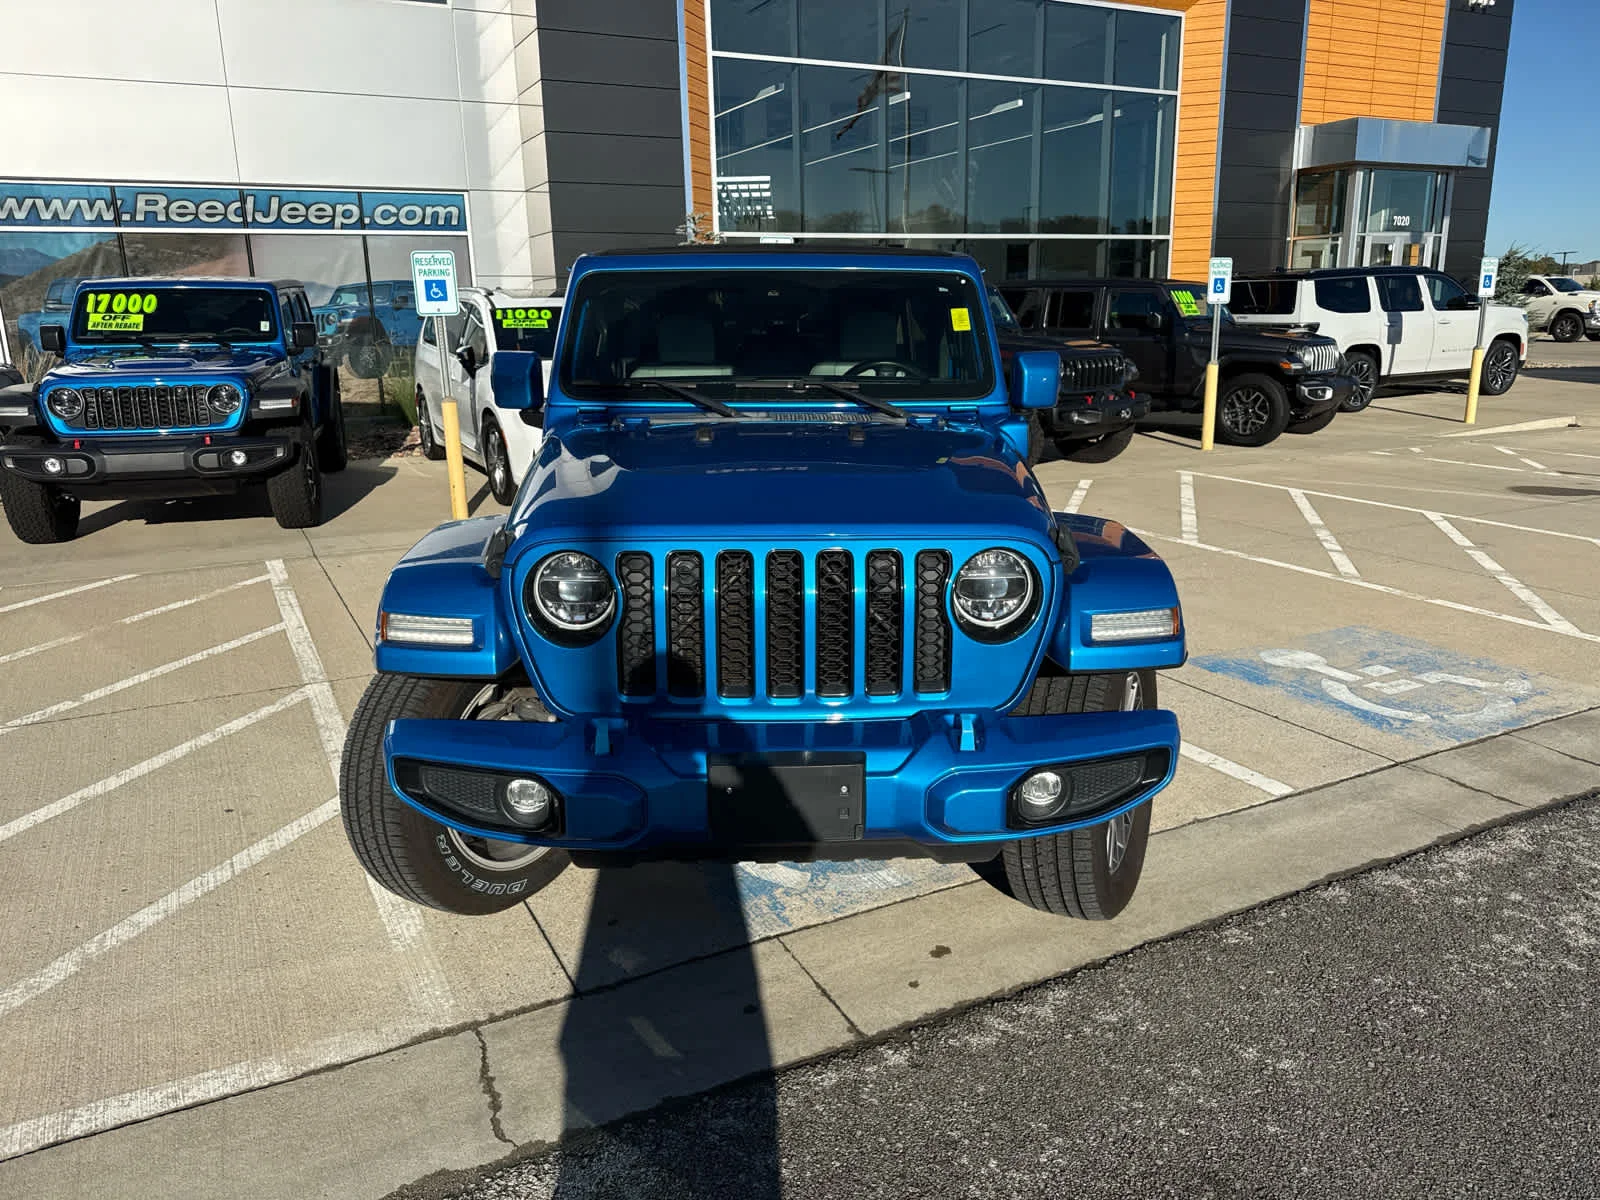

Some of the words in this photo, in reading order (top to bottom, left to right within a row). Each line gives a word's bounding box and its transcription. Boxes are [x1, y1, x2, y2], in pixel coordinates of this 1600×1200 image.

[1393, 215, 1410, 226] 7020
[415, 257, 451, 266] RESERVED
[418, 268, 450, 277] PARKING
[86, 293, 158, 314] 17000
[101, 314, 131, 322] OFF
[114, 322, 140, 330] REBATE
[436, 834, 529, 895] DUELER
